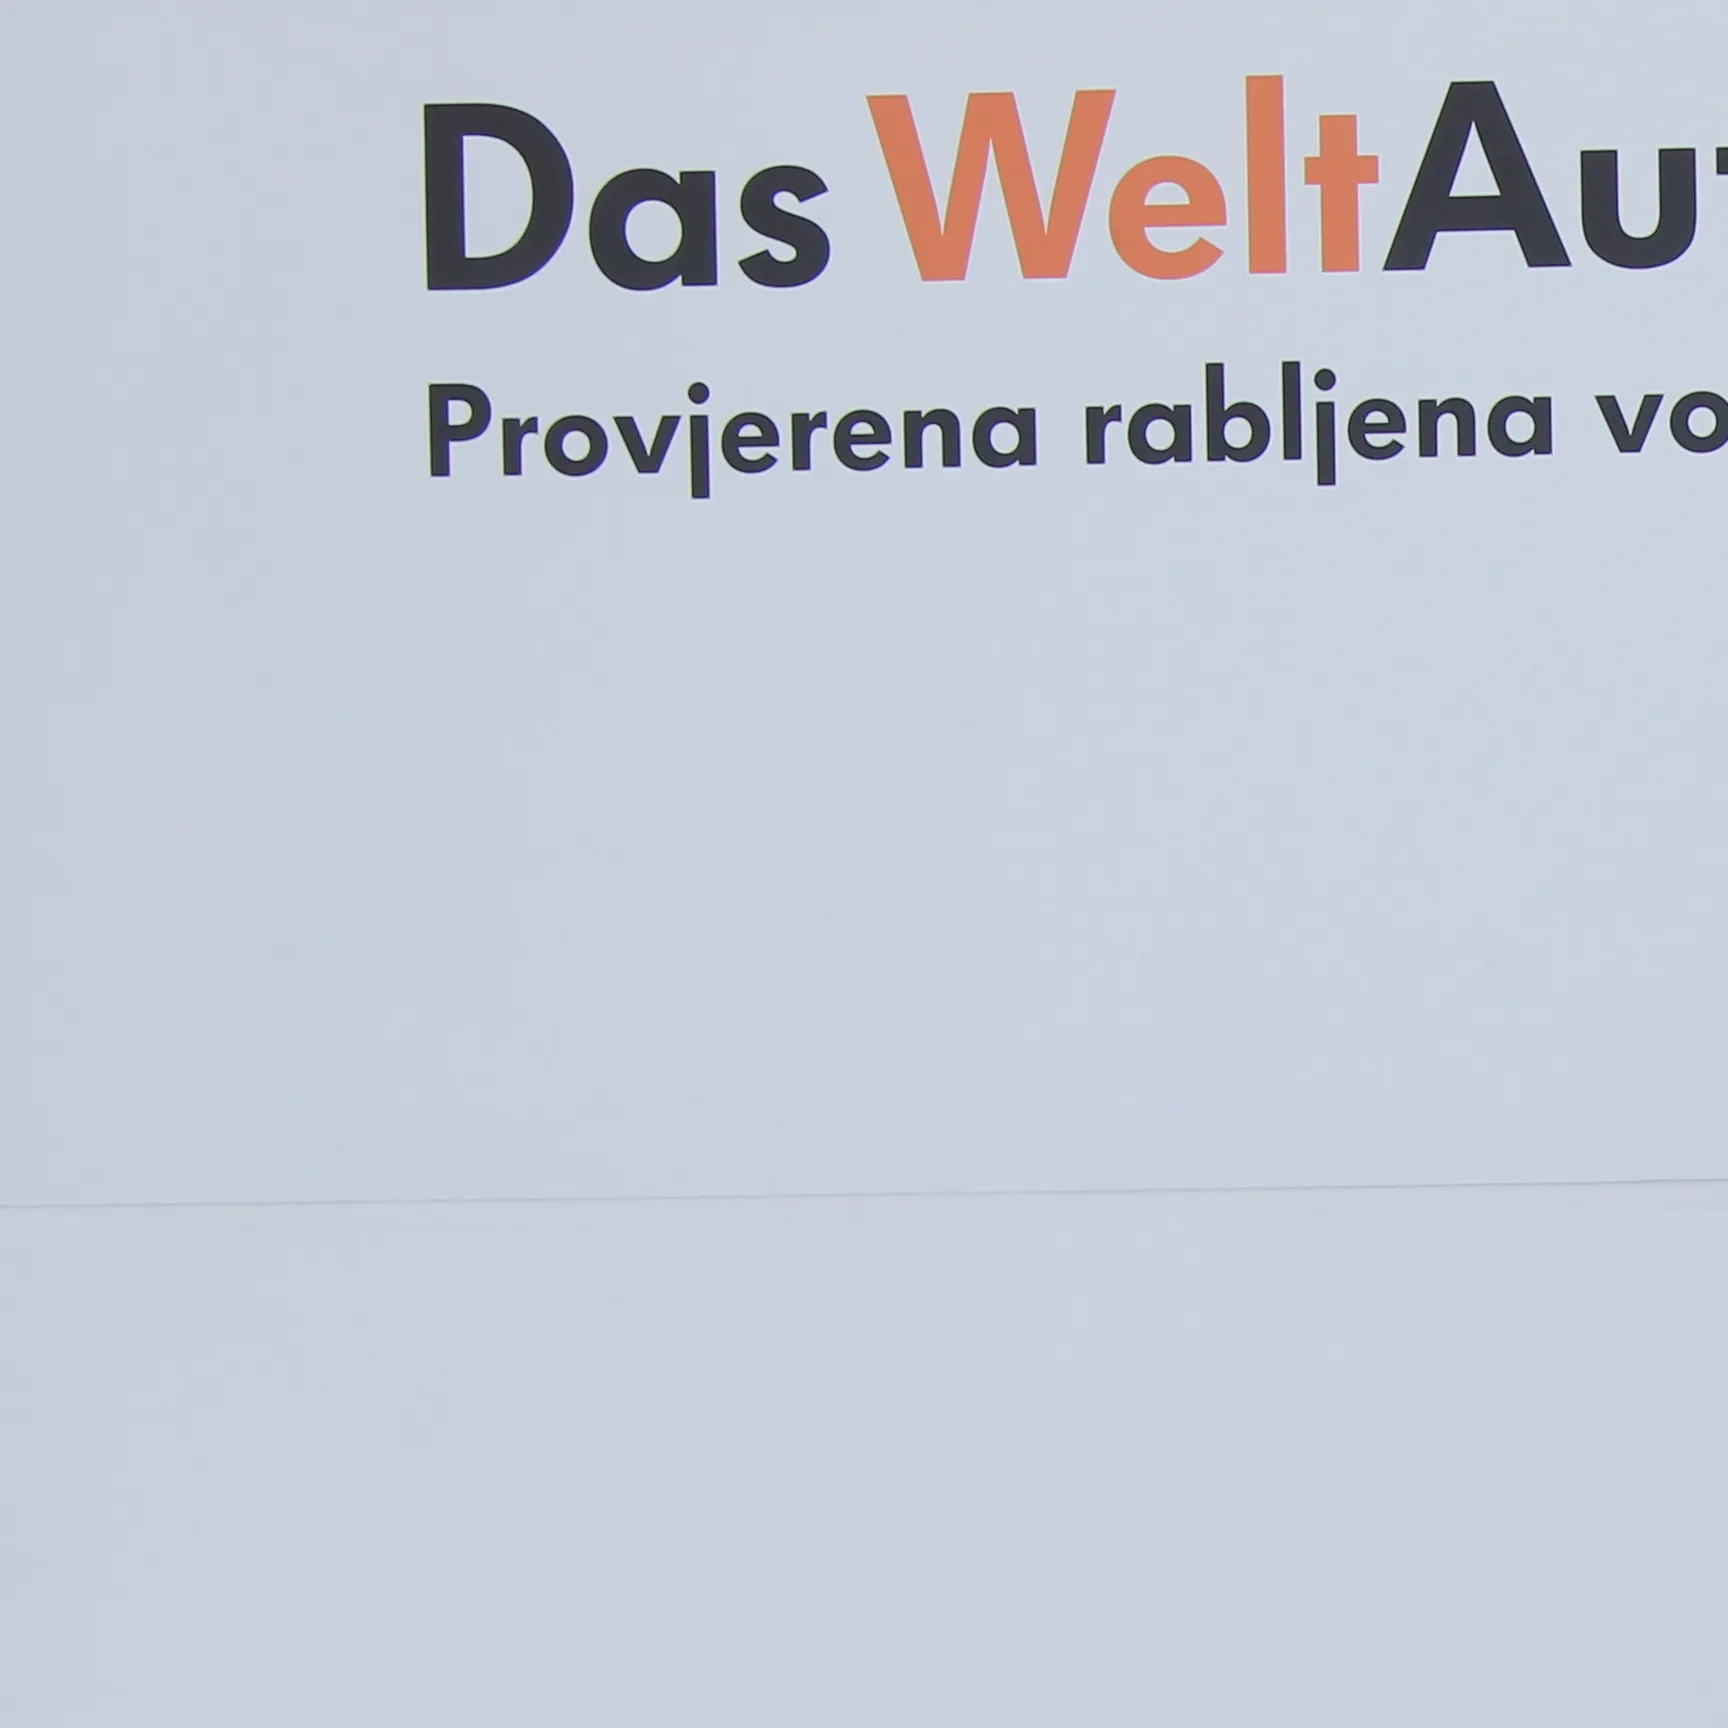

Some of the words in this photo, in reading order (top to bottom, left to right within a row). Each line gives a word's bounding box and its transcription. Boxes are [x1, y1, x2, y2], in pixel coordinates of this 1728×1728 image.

[423, 102, 831, 292] Das
[428, 381, 1037, 500] Provjerena
[1085, 360, 1553, 487] rabljena
